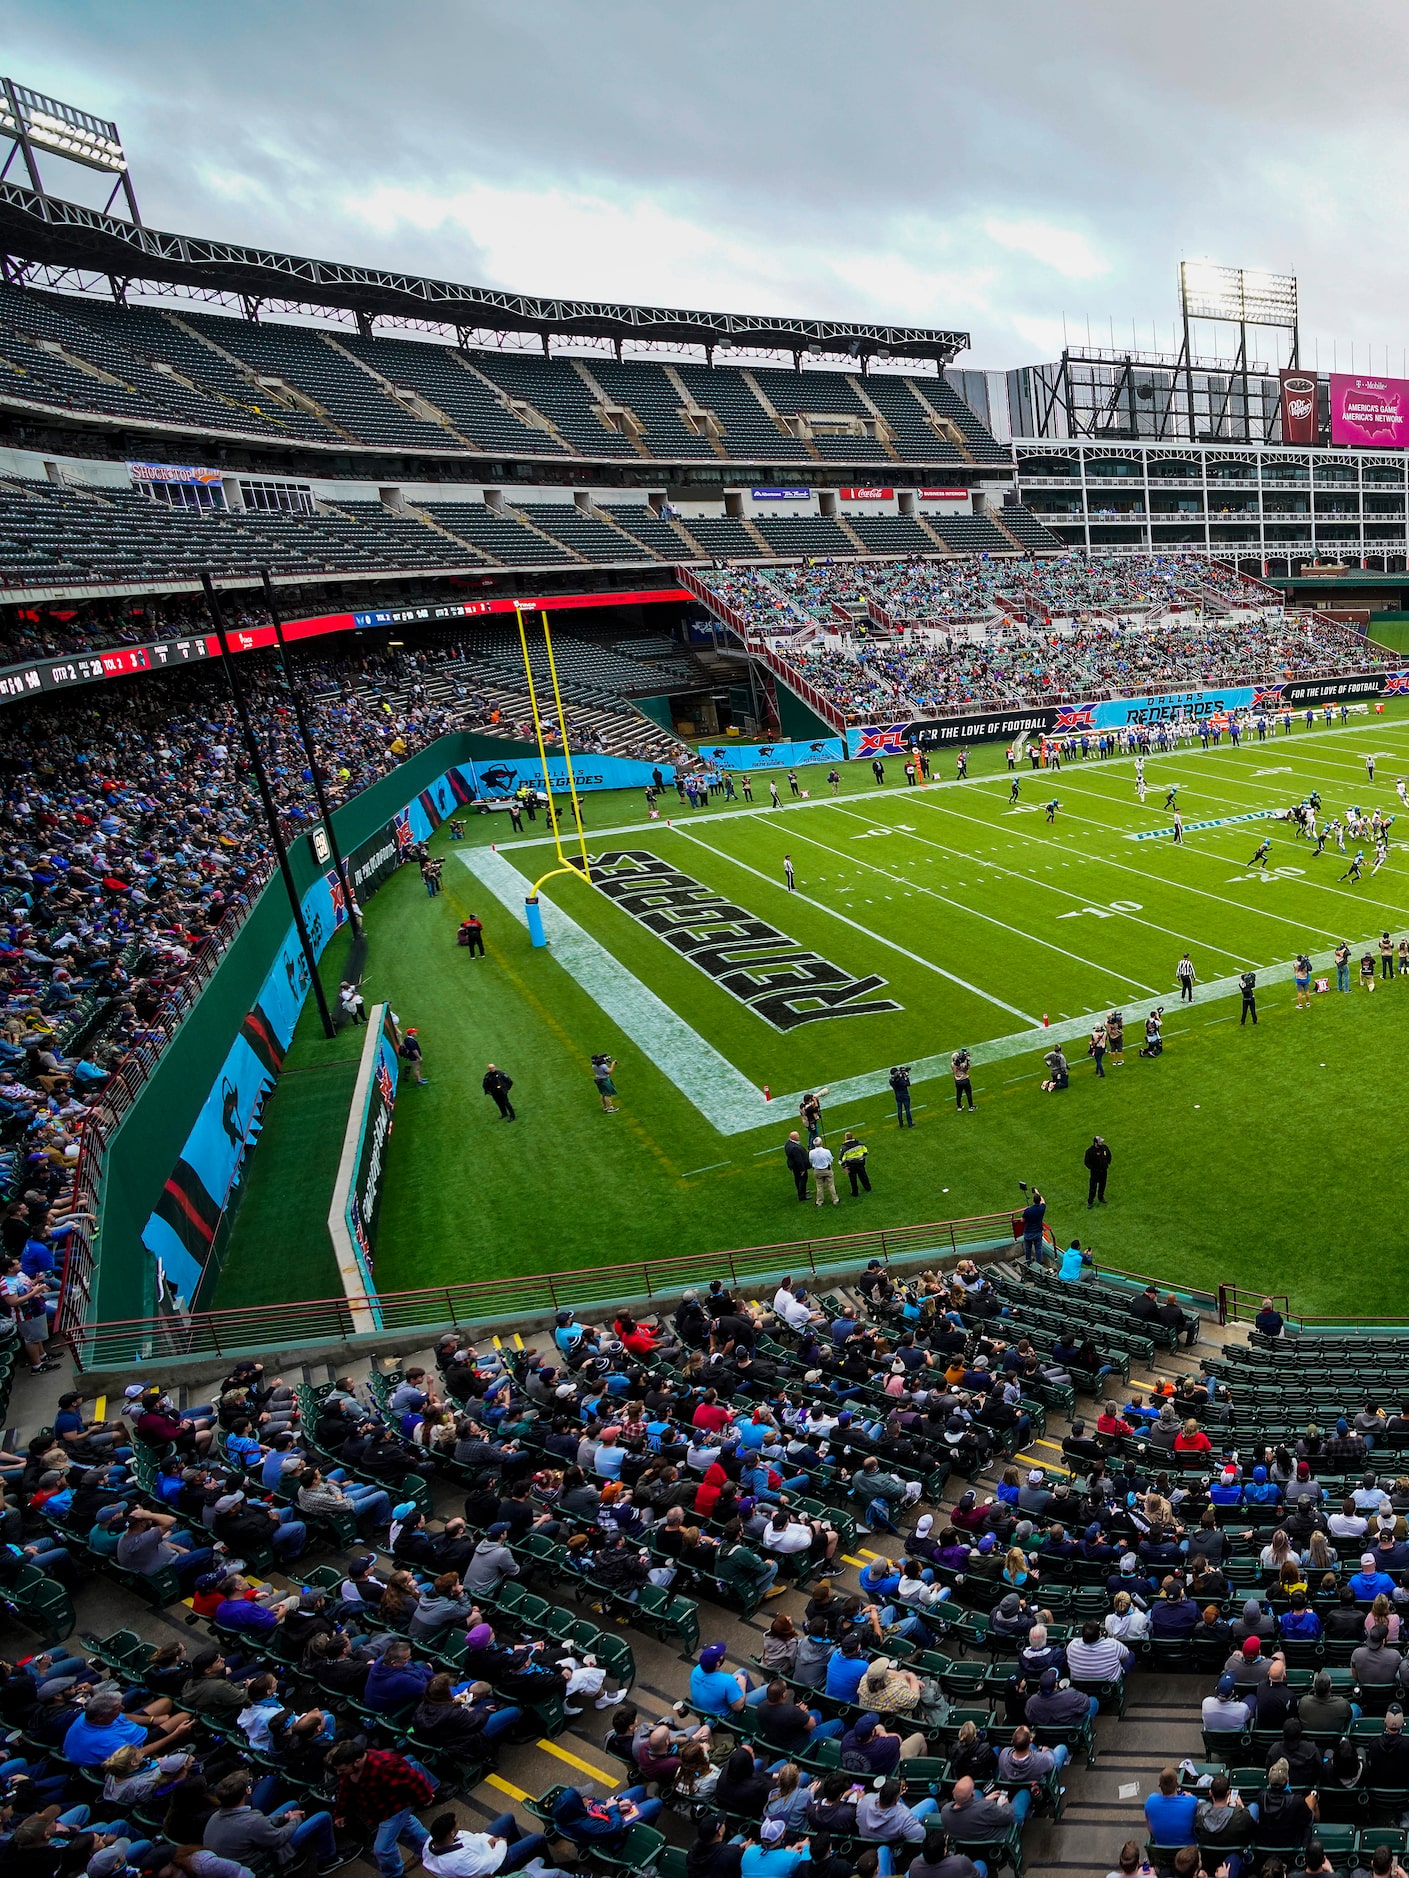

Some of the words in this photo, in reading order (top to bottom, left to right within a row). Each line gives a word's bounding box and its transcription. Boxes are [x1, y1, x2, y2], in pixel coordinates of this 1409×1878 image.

[1289, 402, 1312, 417] Pepper
[1296, 399, 1305, 407] Dr
[1347, 403, 1379, 413] AMERICA'S
[1380, 404, 1398, 414] GAME
[1342, 413, 1374, 422] AMERICA'S
[1374, 414, 1404, 423] NETWORK
[132, 464, 170, 480] SHOCK
[172, 469, 192, 481] TOP
[90, 660, 103, 676] 28
[104, 659, 116, 671] TOL
[117, 658, 123, 669] 2
[130, 653, 137, 667] 3
[52, 667, 68, 684] QTR
[67, 665, 77, 680] 2
[1291, 688, 1304, 699] FOR
[1307, 687, 1319, 698] THE
[1320, 685, 1337, 696] LOVE
[1338, 684, 1347, 694] OF
[1348, 681, 1379, 693] FOOTBALL
[1147, 692, 1204, 706] DALLAS
[940, 726, 959, 739] THE
[961, 724, 985, 737] LOVE
[987, 723, 1000, 733] OF
[1002, 717, 1047, 733] FOOTBALL
[1055, 712, 1097, 728] XFL
[859, 733, 909, 751] XFL
[1245, 866, 1307, 884] 20
[1082, 900, 1144, 919] 10
[568, 849, 906, 1034] RENEGADES
